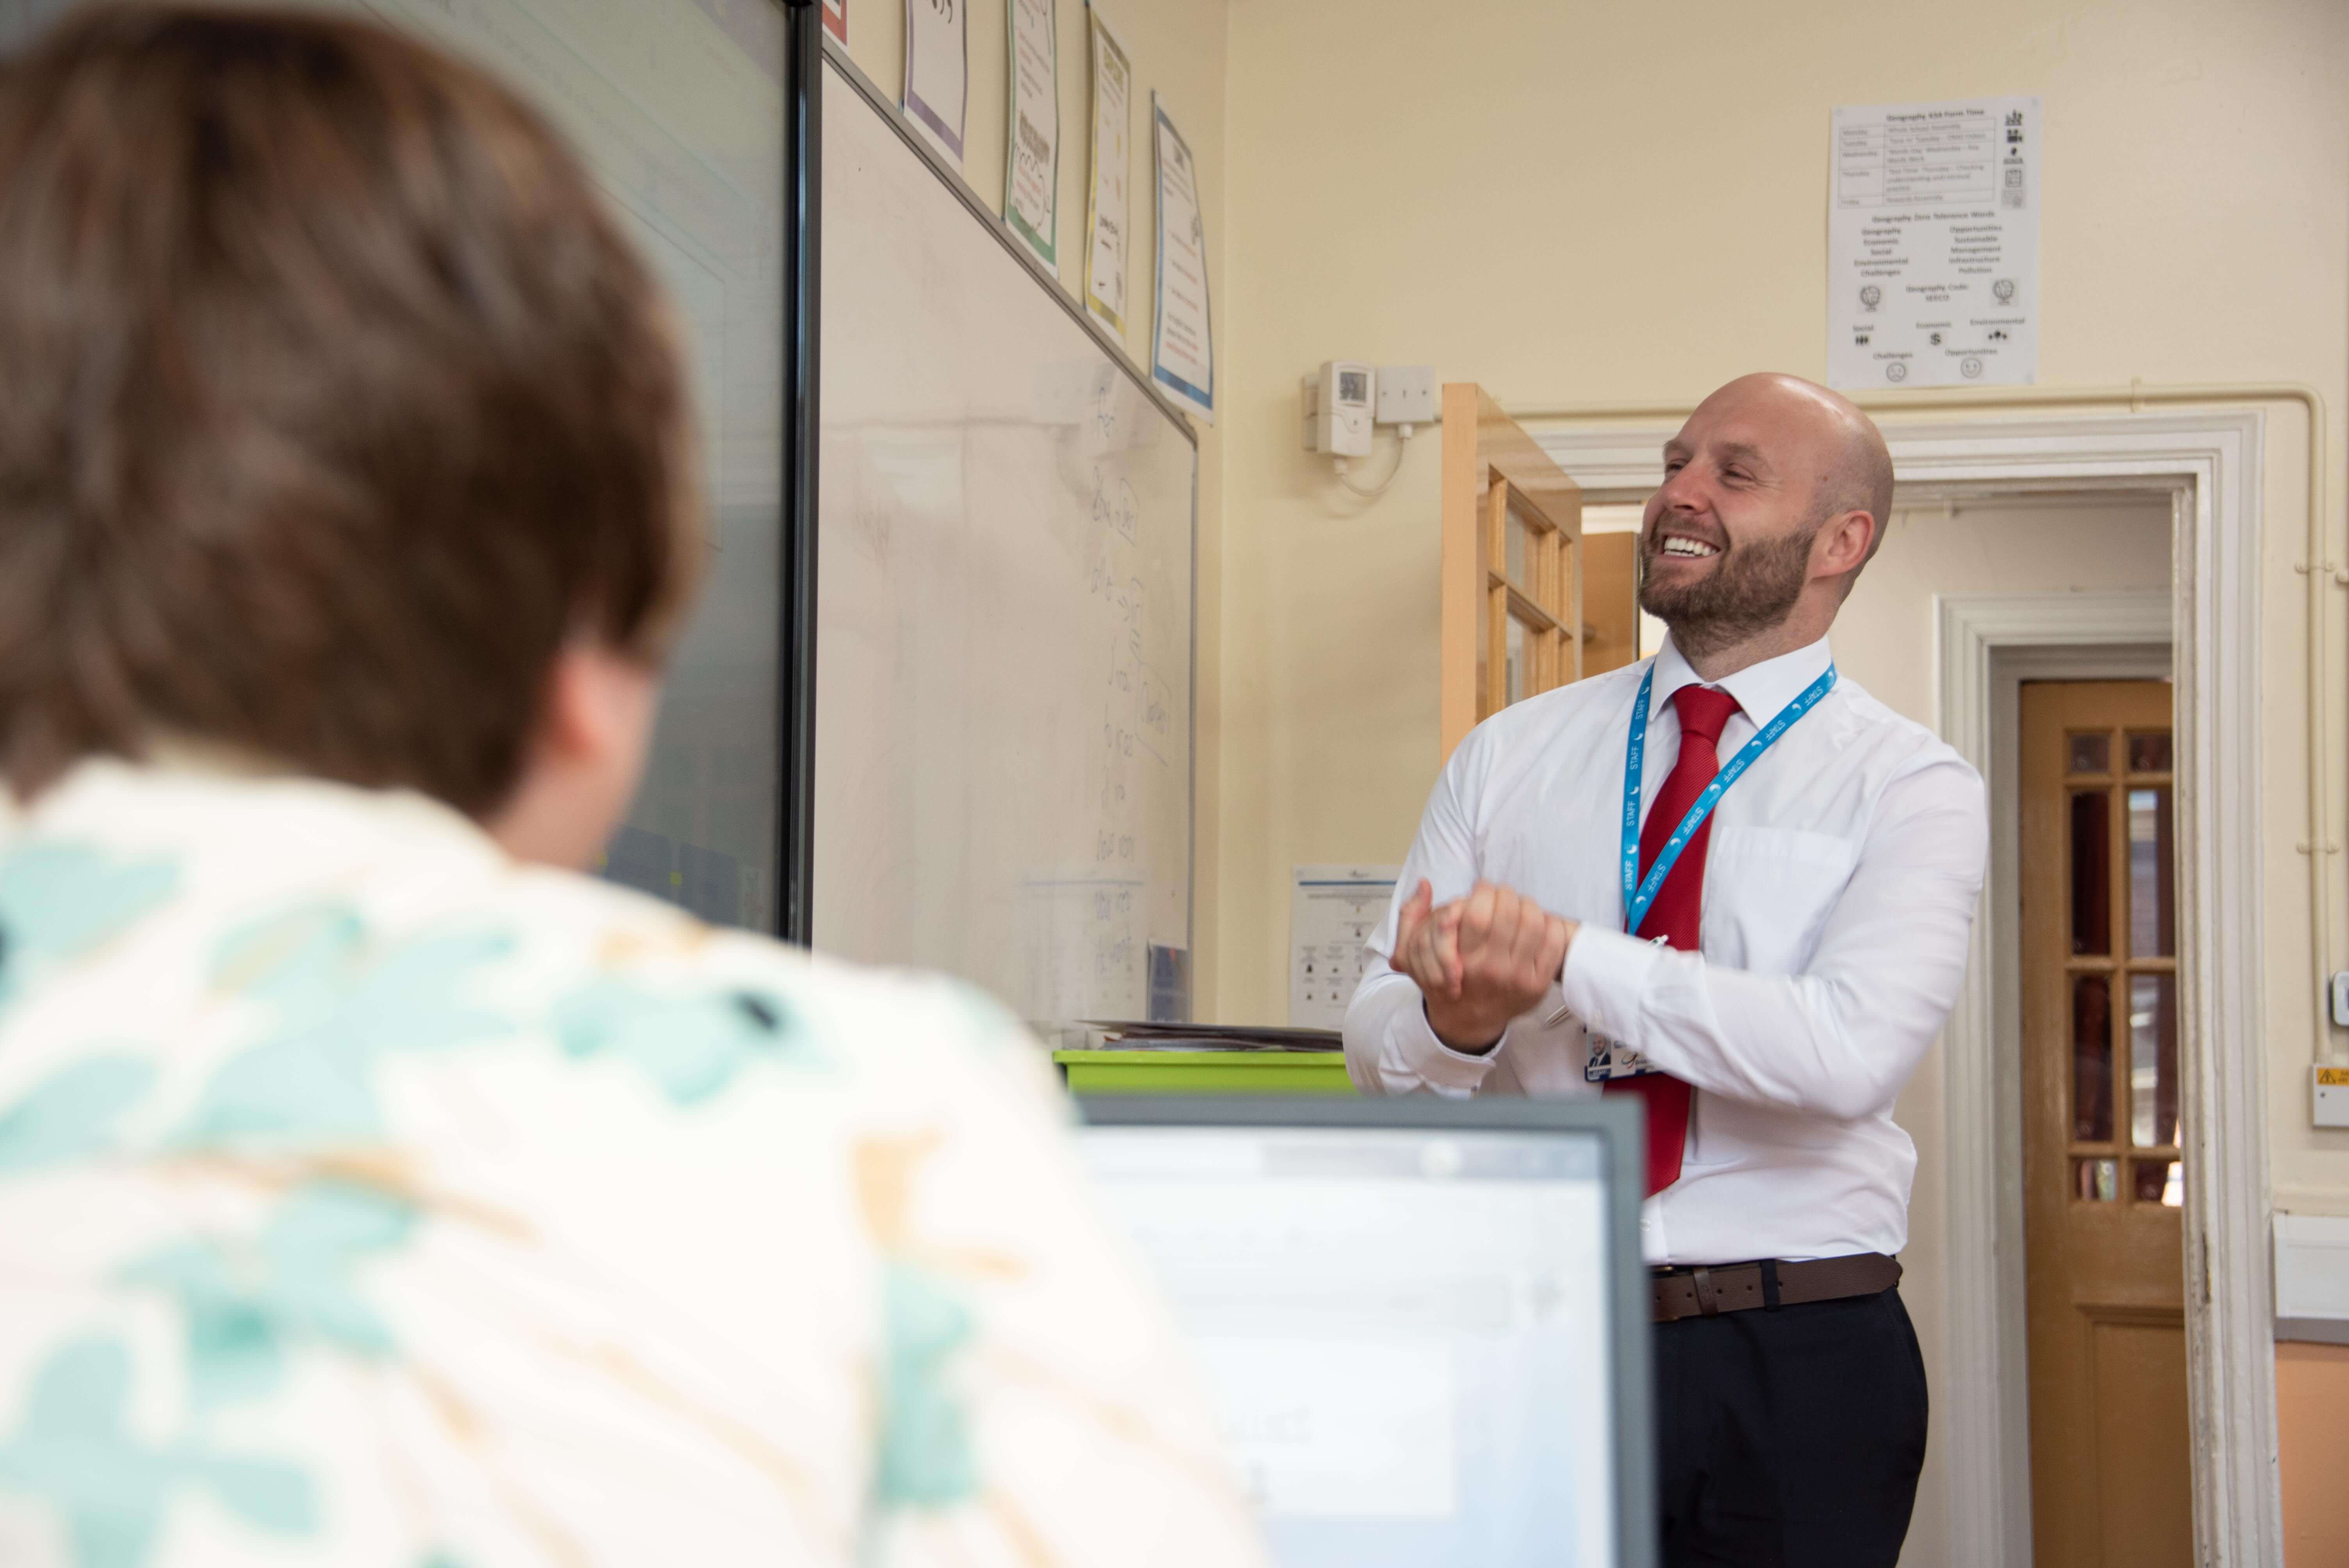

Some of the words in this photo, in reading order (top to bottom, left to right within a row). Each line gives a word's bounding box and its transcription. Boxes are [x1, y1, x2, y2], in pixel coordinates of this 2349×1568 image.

[1886, 112, 1926, 122] Geography
[1872, 215, 1912, 224] Geography
[1934, 212, 1968, 220] Tolerance
[1971, 210, 1995, 219] Words
[1861, 227, 1902, 237] Geography
[1950, 225, 2002, 234] Opportunities
[1863, 238, 1899, 246] Economic
[1954, 235, 1998, 244] Sustainable
[1950, 246, 2001, 255] Management
[1854, 257, 1908, 267] Environmental
[1948, 256, 2000, 264] Infrastructure
[1861, 269, 1901, 278] Challenges
[1905, 284, 1945, 294] Geography
[1916, 321, 1952, 329] Economic
[1970, 317, 2025, 326] Environmental
[1944, 348, 1998, 356] Opportunities
[1804, 685, 1823, 706] STAFF
[1635, 700, 1645, 720] STAFF
[1765, 719, 1786, 741] STAFF
[1629, 746, 1639, 770] STAFF
[1723, 759, 1745, 784] STAFF
[1626, 800, 1635, 827] STAFF
[1682, 806, 1704, 836] STAFF
[1625, 860, 1634, 891] STAFF
[1647, 863, 1666, 893] STAFF
